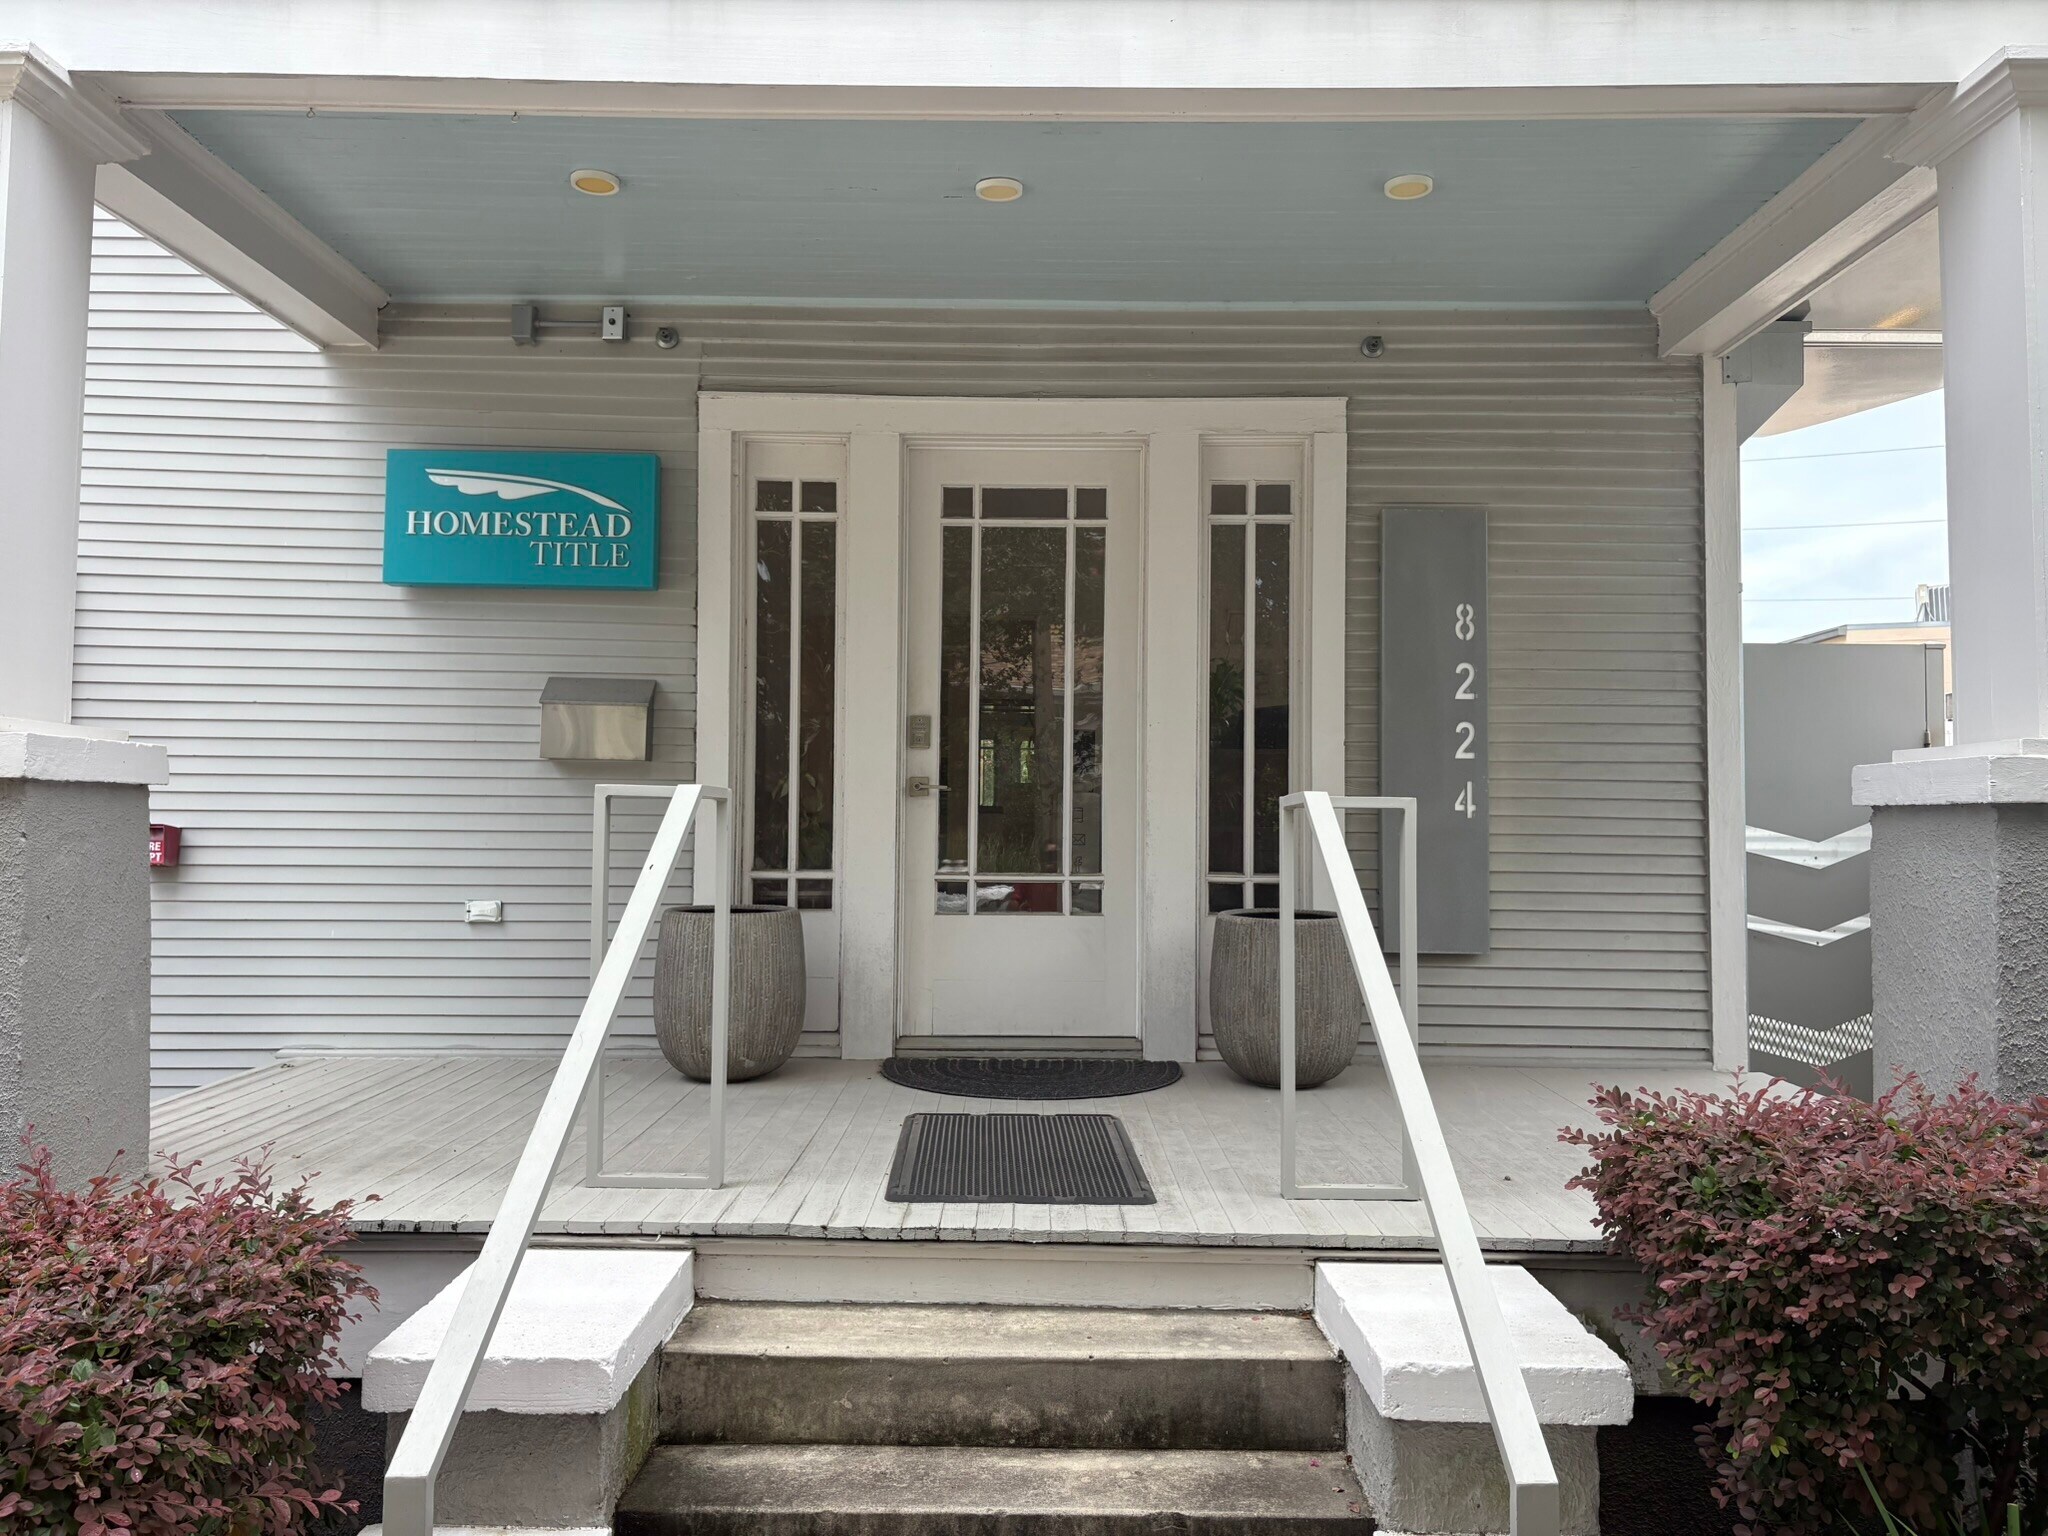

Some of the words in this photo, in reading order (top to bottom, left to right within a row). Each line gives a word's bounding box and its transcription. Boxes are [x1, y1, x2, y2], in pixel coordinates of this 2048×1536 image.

[405, 510, 632, 538] HOMESTEAD
[529, 541, 631, 567] TITLE
[149, 841, 161, 851] RE
[149, 852, 162, 862] PT
